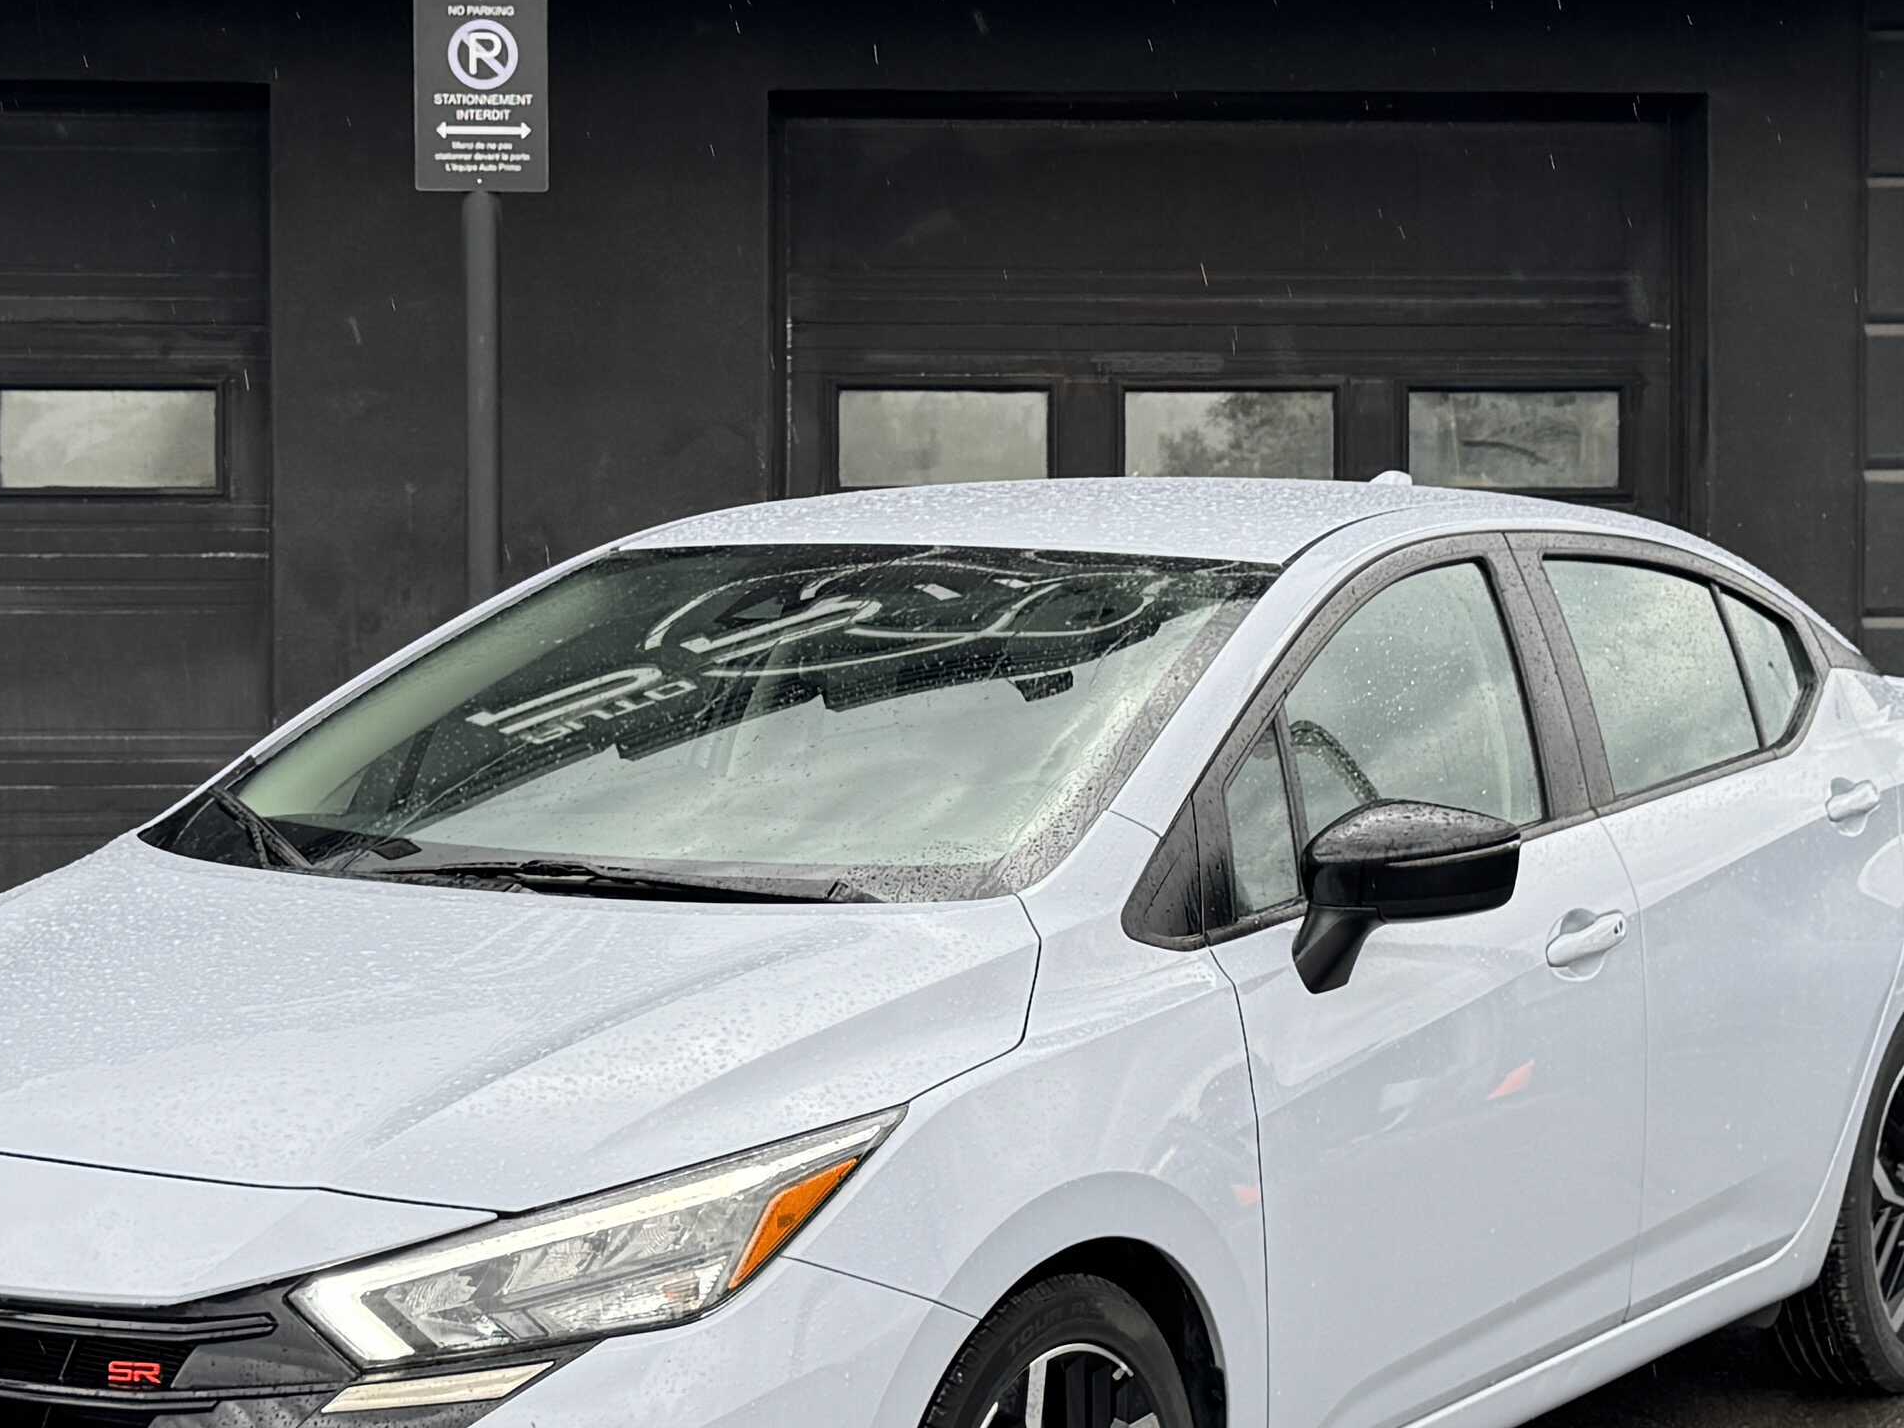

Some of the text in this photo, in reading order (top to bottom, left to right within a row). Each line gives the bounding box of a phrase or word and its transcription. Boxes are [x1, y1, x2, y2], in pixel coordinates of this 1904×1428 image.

[448, 5, 514, 17] NO PARKING
[433, 93, 533, 105] STATIONNEMENT
[456, 109, 511, 121] INTERDIT
[108, 1360, 161, 1384] SR
